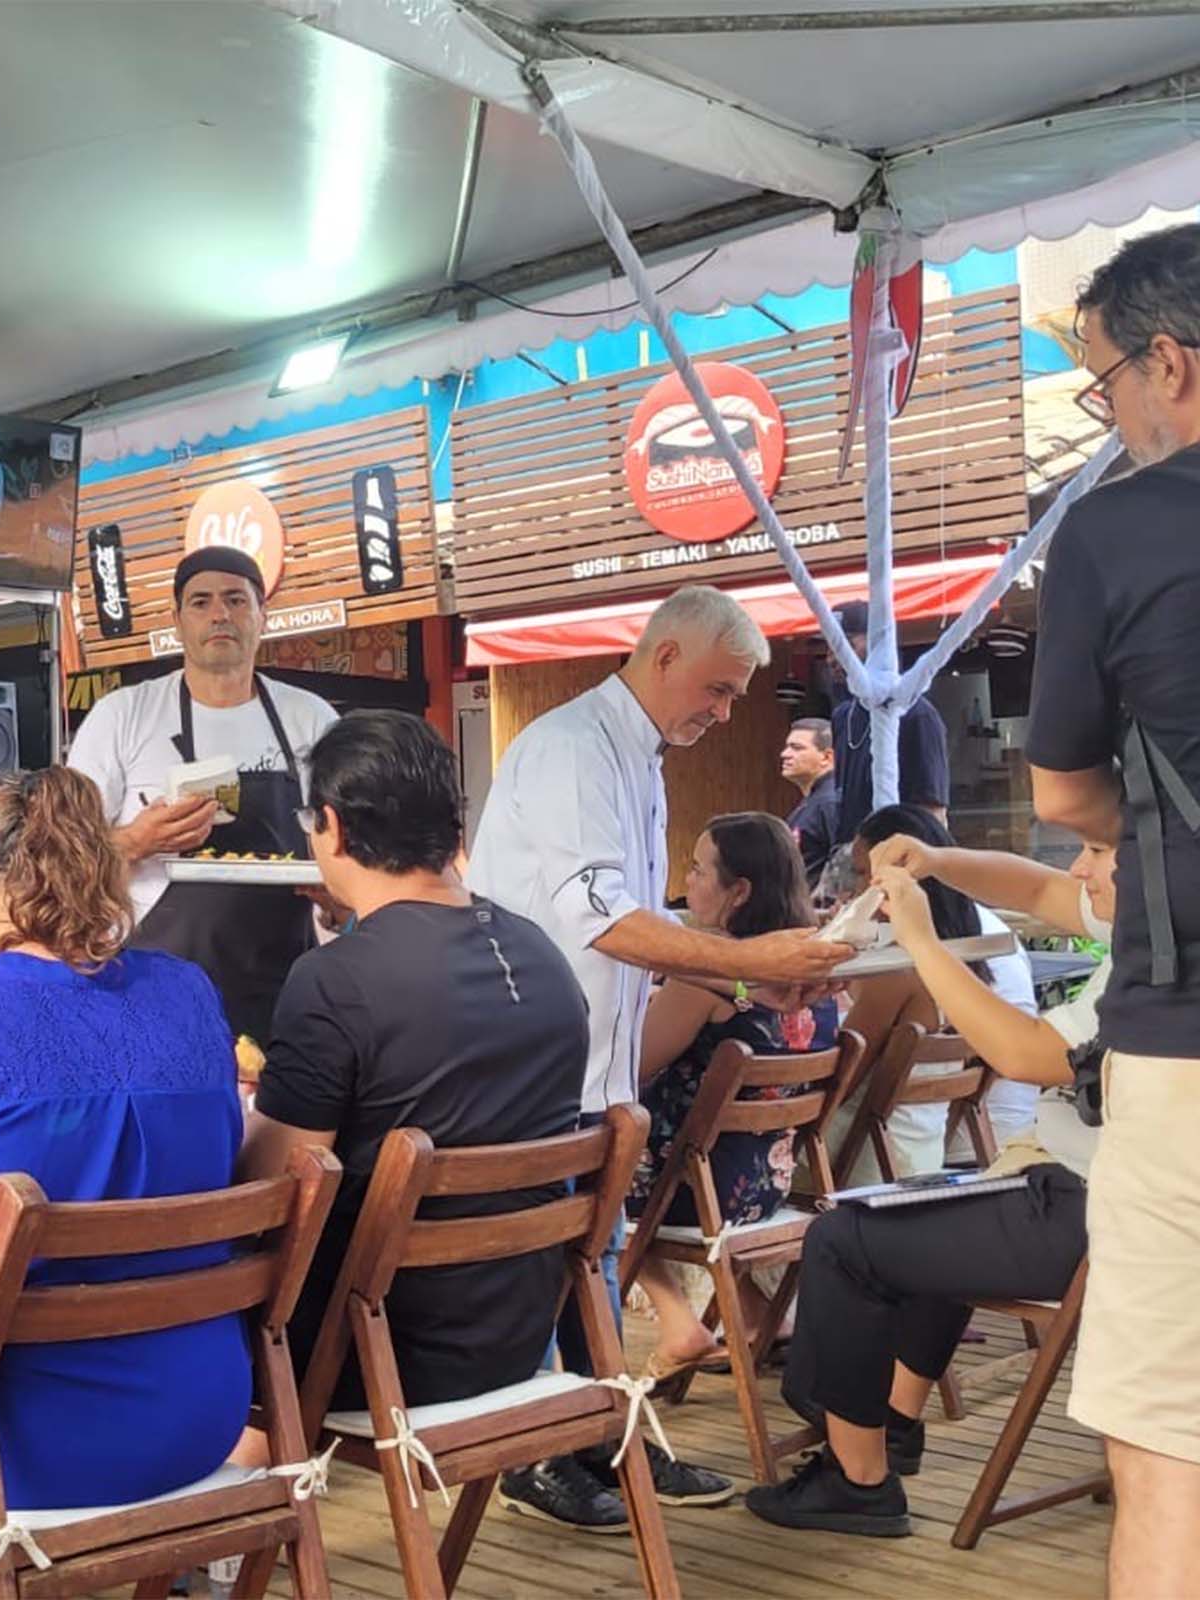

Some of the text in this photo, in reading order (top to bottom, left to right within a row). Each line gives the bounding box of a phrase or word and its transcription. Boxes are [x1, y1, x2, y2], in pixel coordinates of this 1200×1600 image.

[571, 556, 622, 579] SUSHI
[639, 544, 708, 569] TEMAKI
[289, 608, 334, 627] HORA
